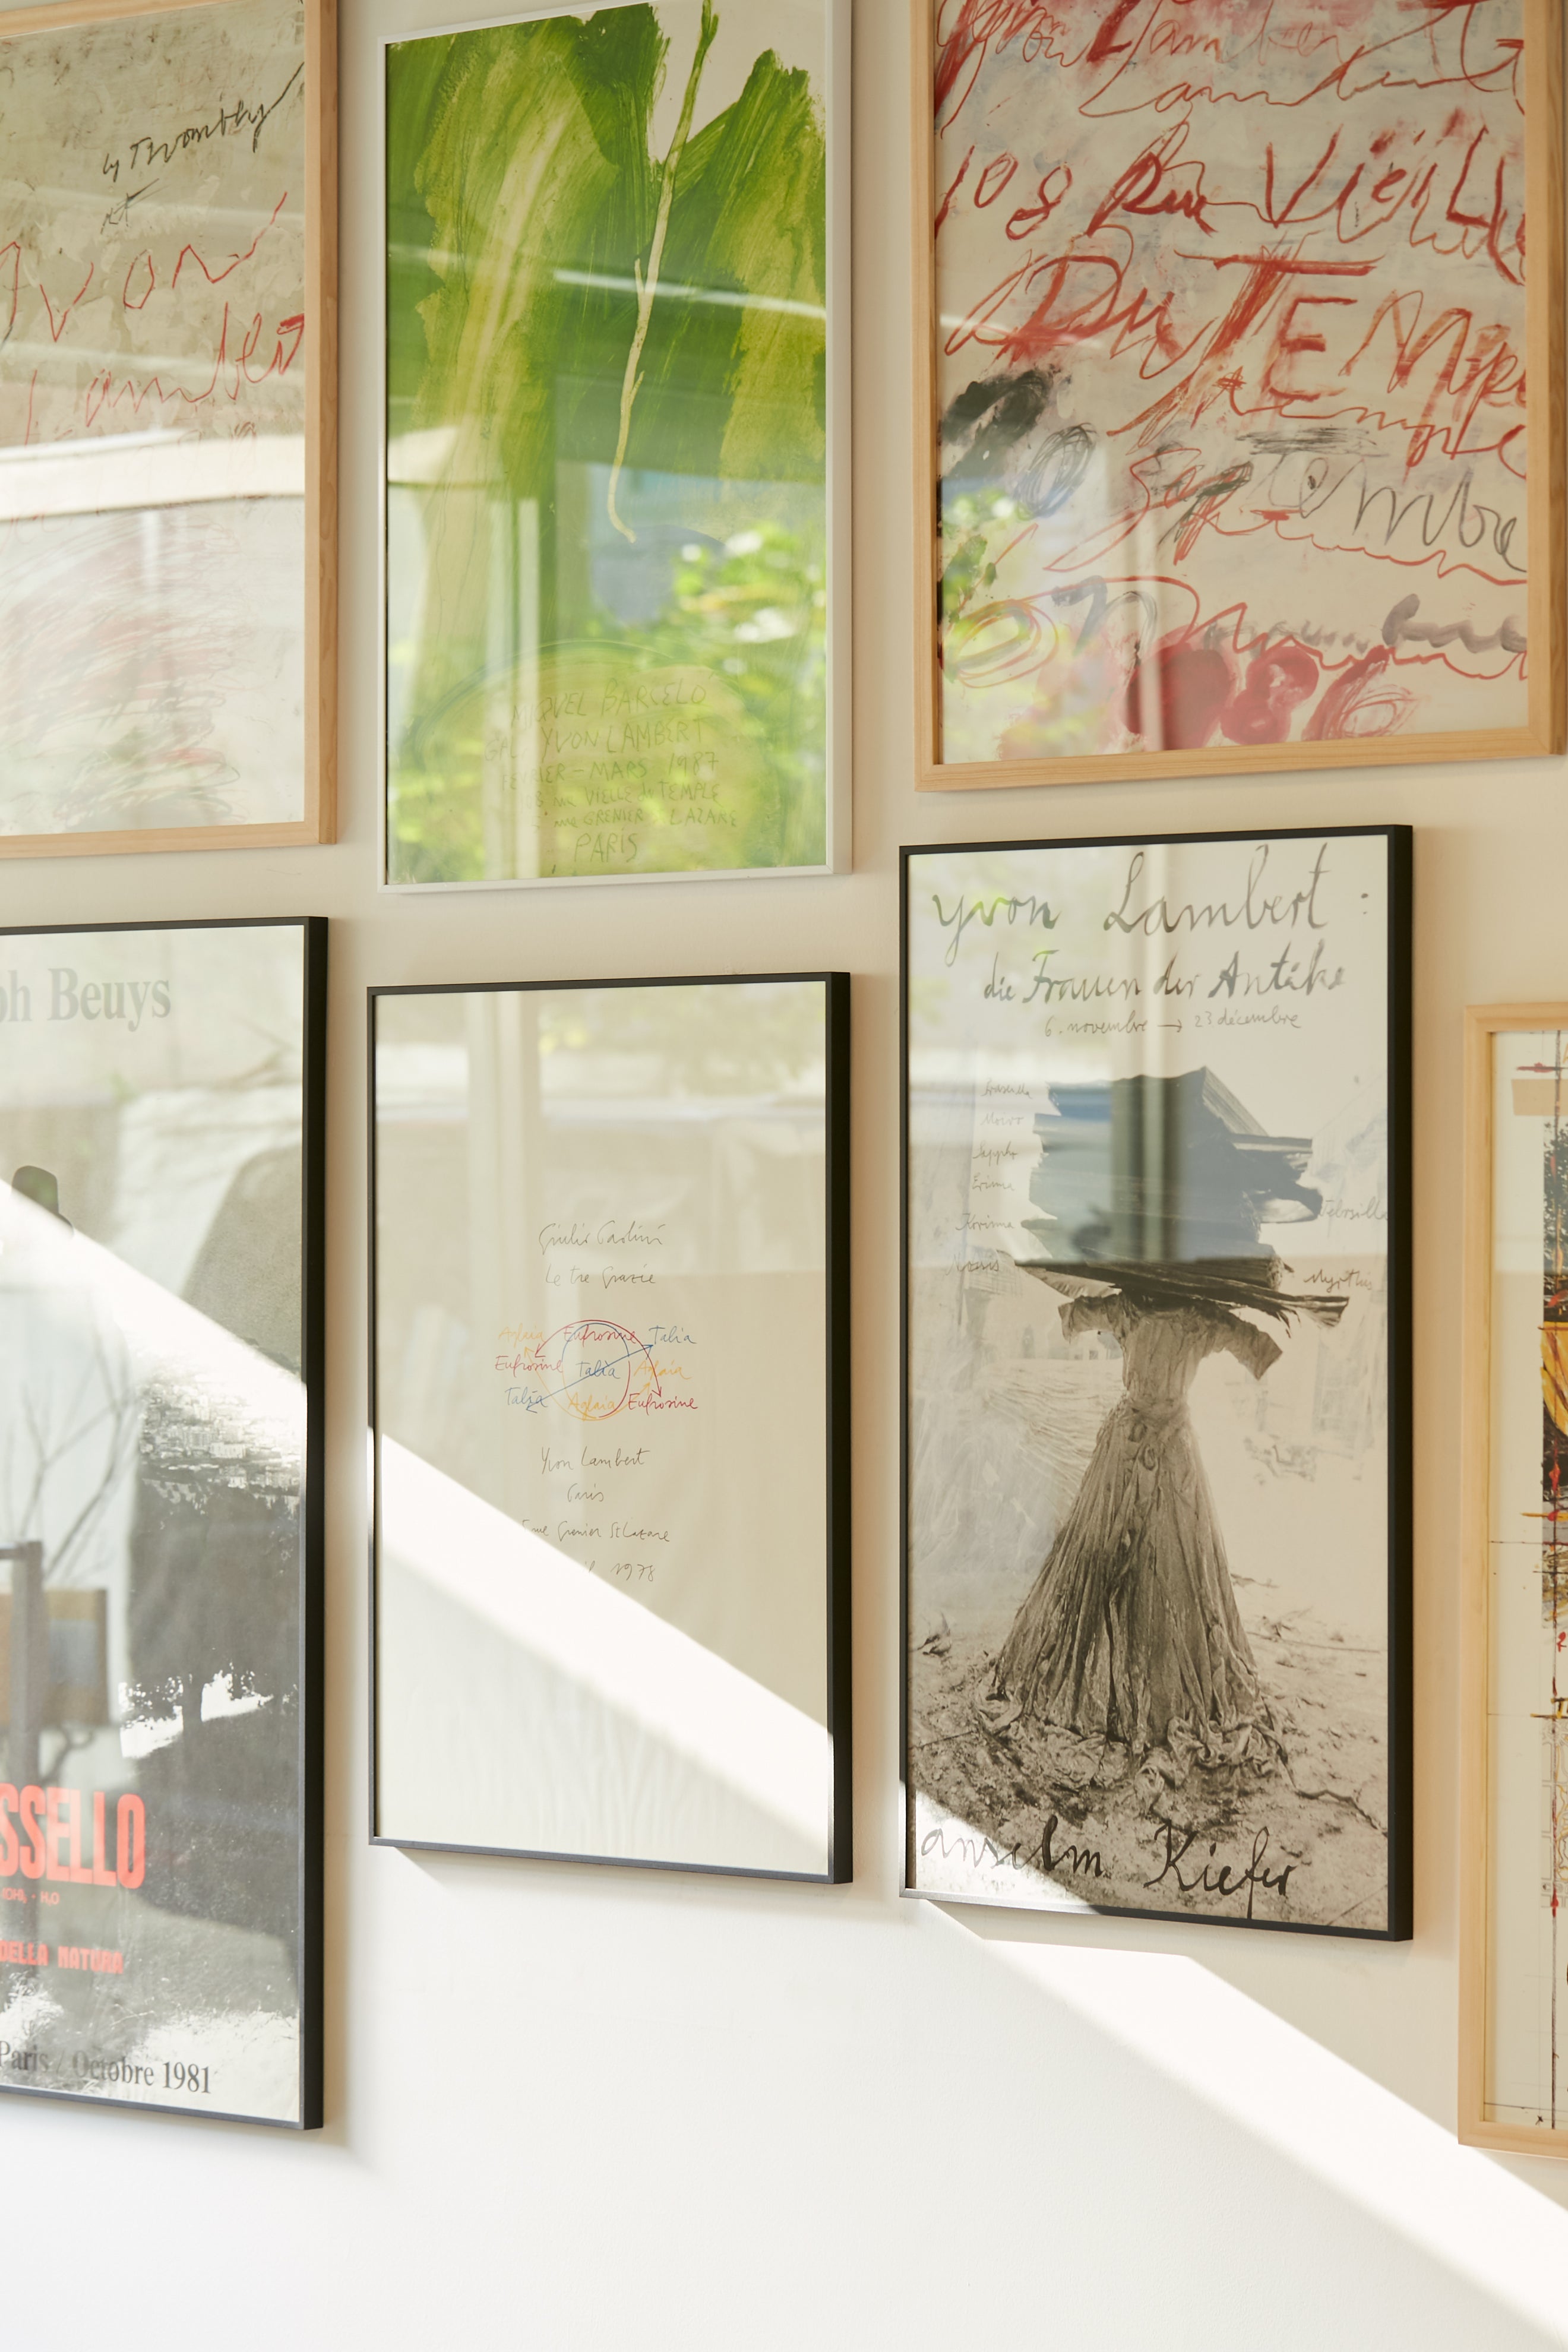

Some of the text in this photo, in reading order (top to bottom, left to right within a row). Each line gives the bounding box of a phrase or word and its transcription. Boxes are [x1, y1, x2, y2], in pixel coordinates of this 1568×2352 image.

[541, 726, 599, 763] YVON
[607, 715, 708, 753] LAMBERT
[590, 758, 647, 781] MARS
[668, 751, 720, 777] 1987
[583, 808, 644, 827] GRENIER
[669, 808, 736, 828] LAZARE
[1022, 949, 1142, 1004] Frauen
[47, 968, 172, 1032] Beuys
[1067, 1009, 1149, 1035] novembre
[648, 1325, 698, 1345] Talia
[627, 1391, 698, 1416] Eufrosine
[580, 1445, 652, 1469] Lambert
[609, 1563, 656, 1582] 1978
[1143, 1818, 1297, 1920] Kiefer
[0, 1939, 124, 1975] DELLA NATURA
[0, 2040, 49, 2073] Paris
[72, 2049, 154, 2086] Octobre
[162, 2061, 211, 2094] 1981
